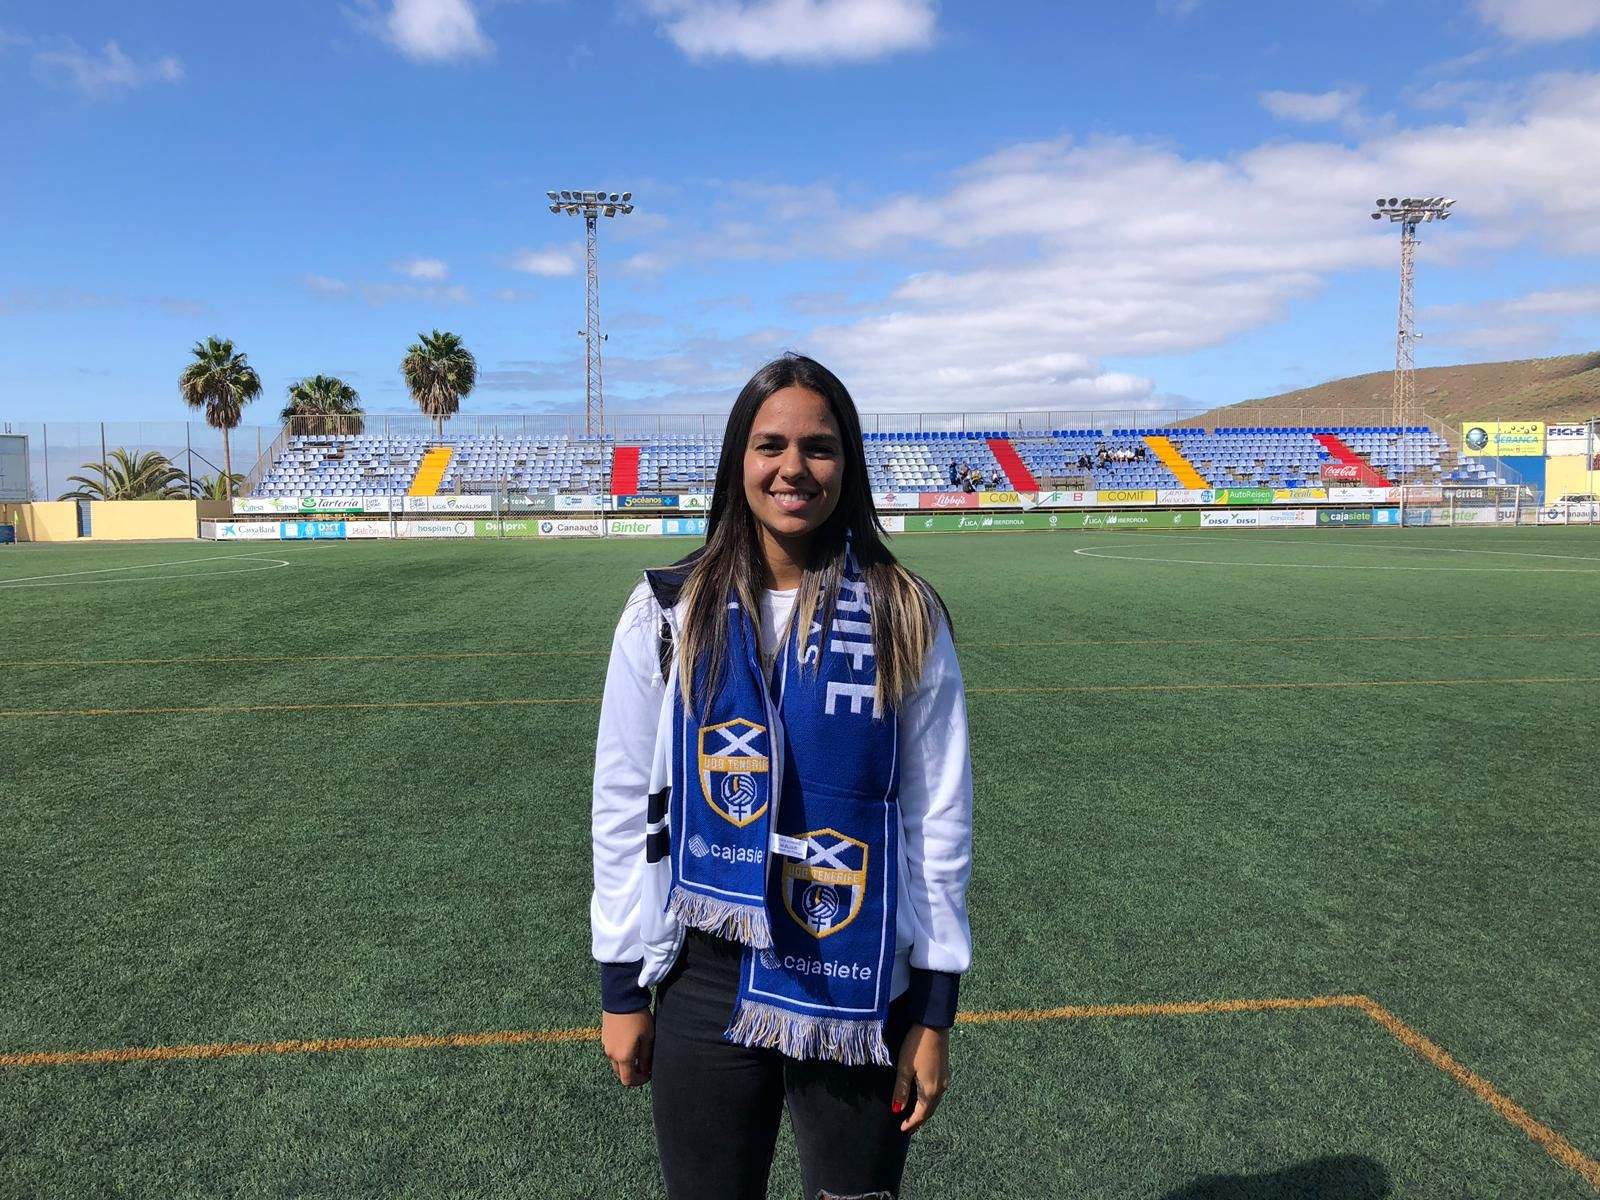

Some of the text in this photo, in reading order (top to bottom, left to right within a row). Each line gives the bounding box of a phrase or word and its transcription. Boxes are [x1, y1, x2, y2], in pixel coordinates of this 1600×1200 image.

[1330, 512, 1371, 521] cajasiete
[611, 521, 652, 533] Binter
[710, 843, 764, 865] cajasie
[784, 955, 872, 980] cajasiete
